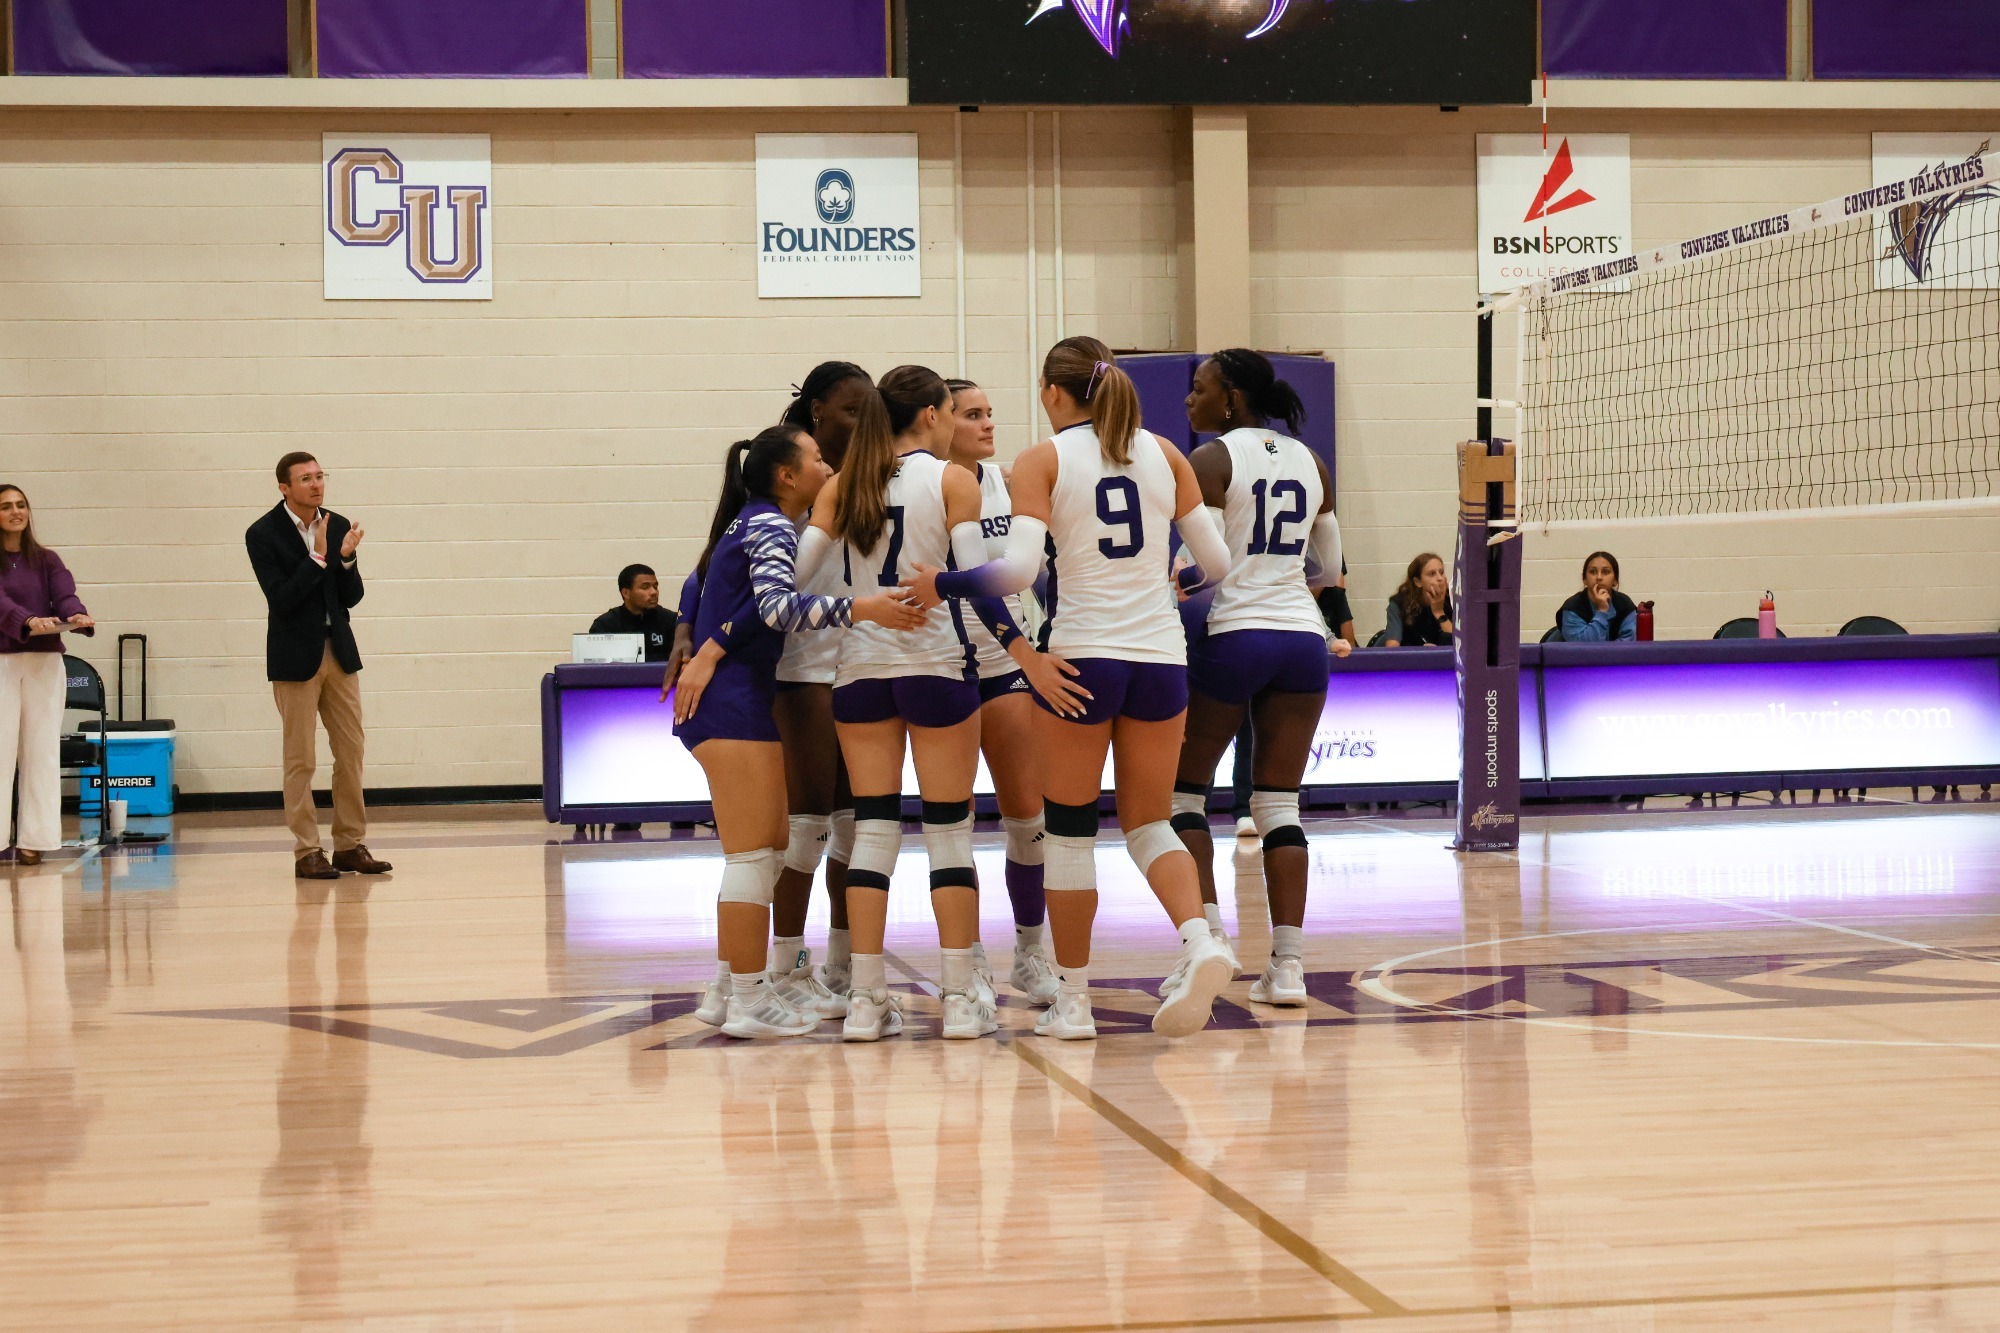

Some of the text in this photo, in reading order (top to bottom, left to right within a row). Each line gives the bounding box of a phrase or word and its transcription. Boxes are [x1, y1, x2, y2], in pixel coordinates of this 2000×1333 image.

[1844, 157, 1985, 216] CONVERSE VALKYRIES
[763, 222, 916, 252] FOUNDERS
[1493, 236, 1618, 254] BSN SPORTS
[1680, 214, 1790, 260] CONVERSE VALKYRIES
[763, 255, 819, 263] FEDERAL
[877, 254, 915, 262] UNION
[1551, 255, 1639, 293] CONVERSE VALKYRIES
[1096, 475, 1144, 560] 9
[1247, 478, 1307, 556] 12
[1485, 689, 1499, 788] sports imports
[93, 777, 153, 787] PWERADE
